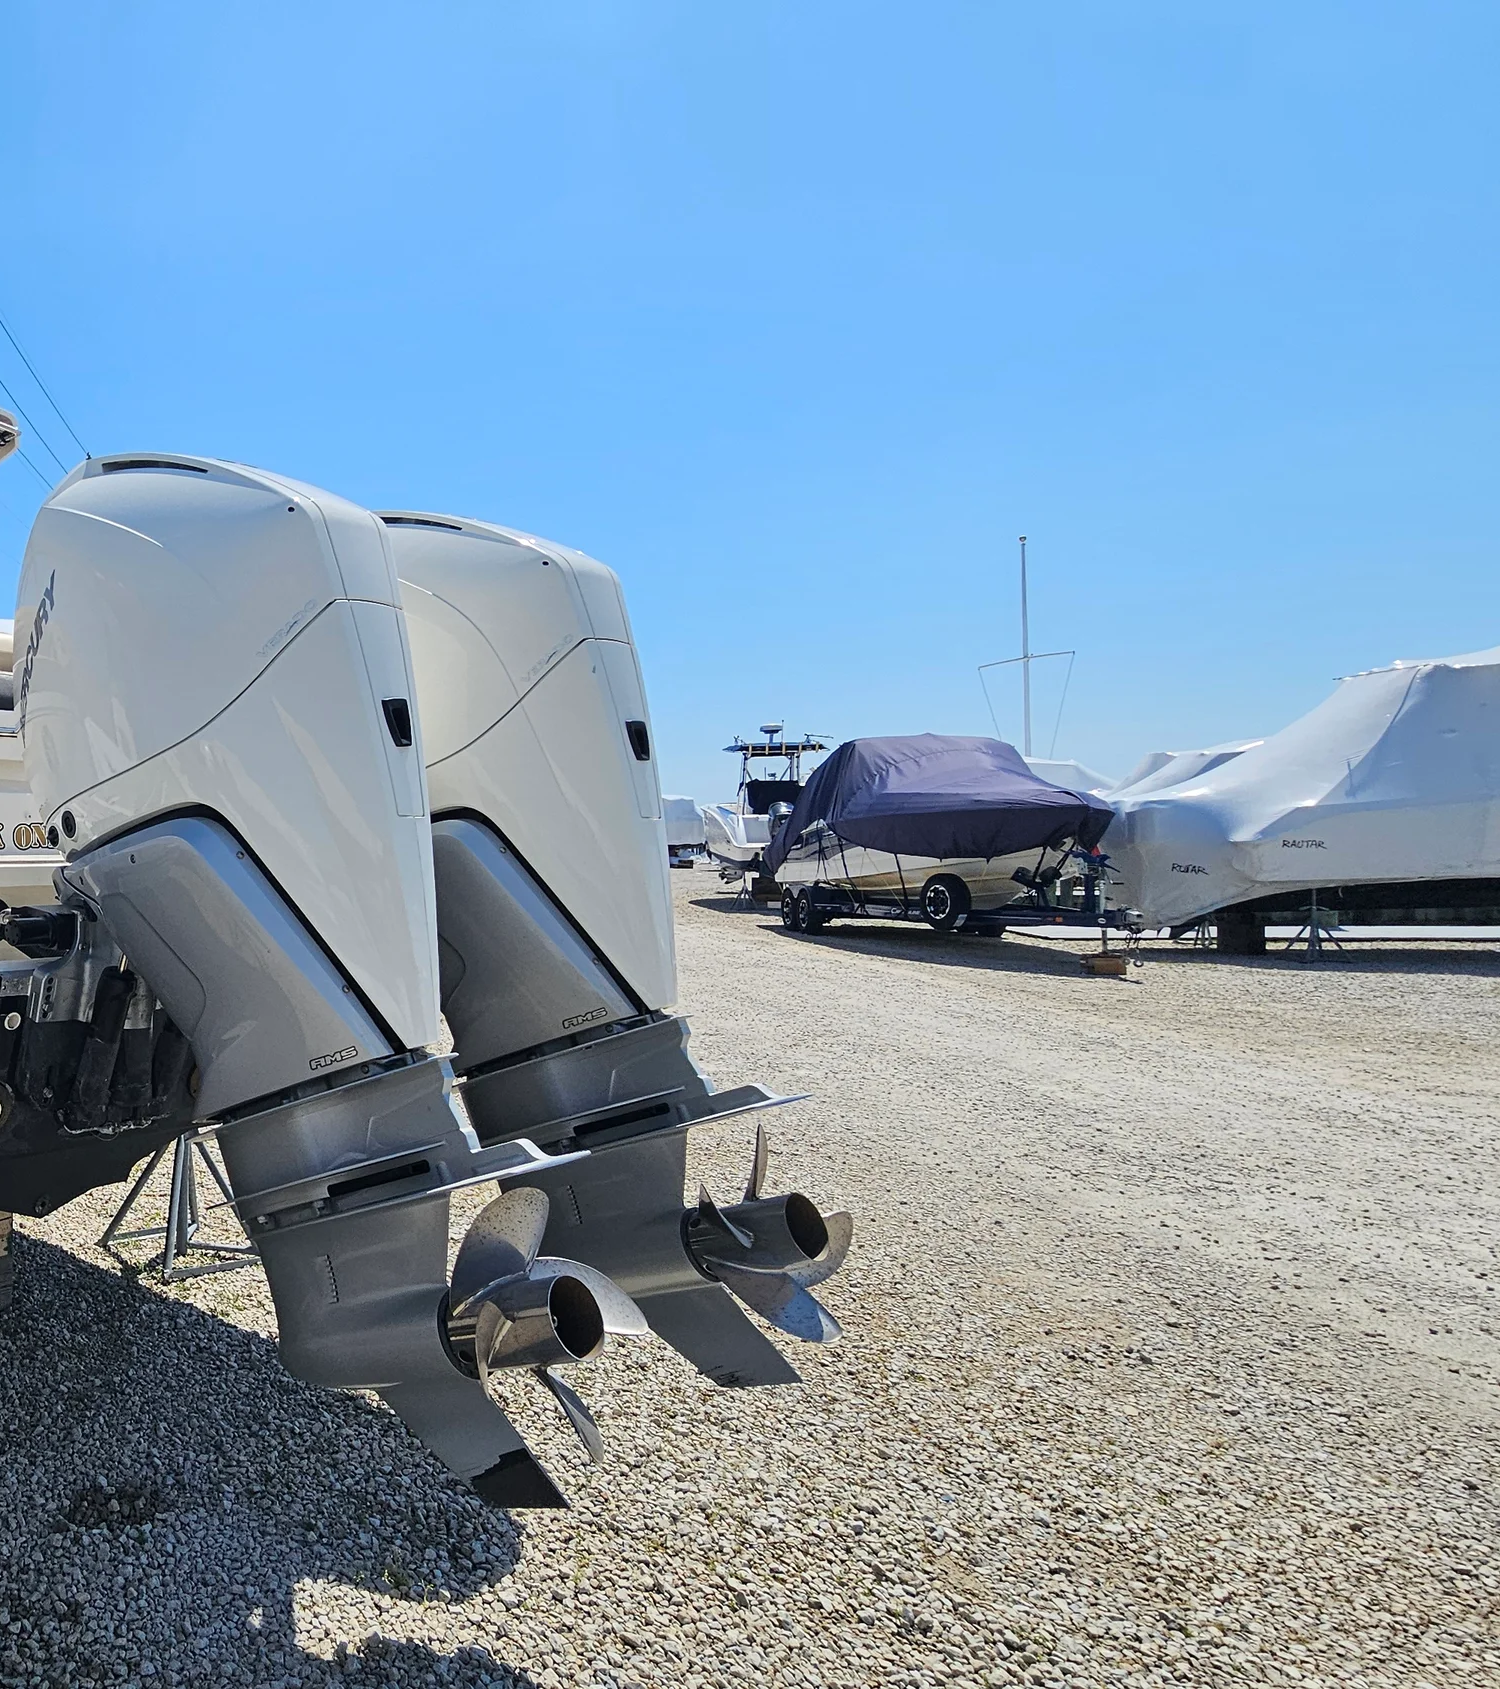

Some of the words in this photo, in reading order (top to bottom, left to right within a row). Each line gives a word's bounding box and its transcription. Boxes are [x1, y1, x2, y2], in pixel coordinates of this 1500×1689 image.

[13, 822, 56, 850] ON
[562, 1007, 607, 1030] AMS
[309, 1045, 358, 1071] AMS
